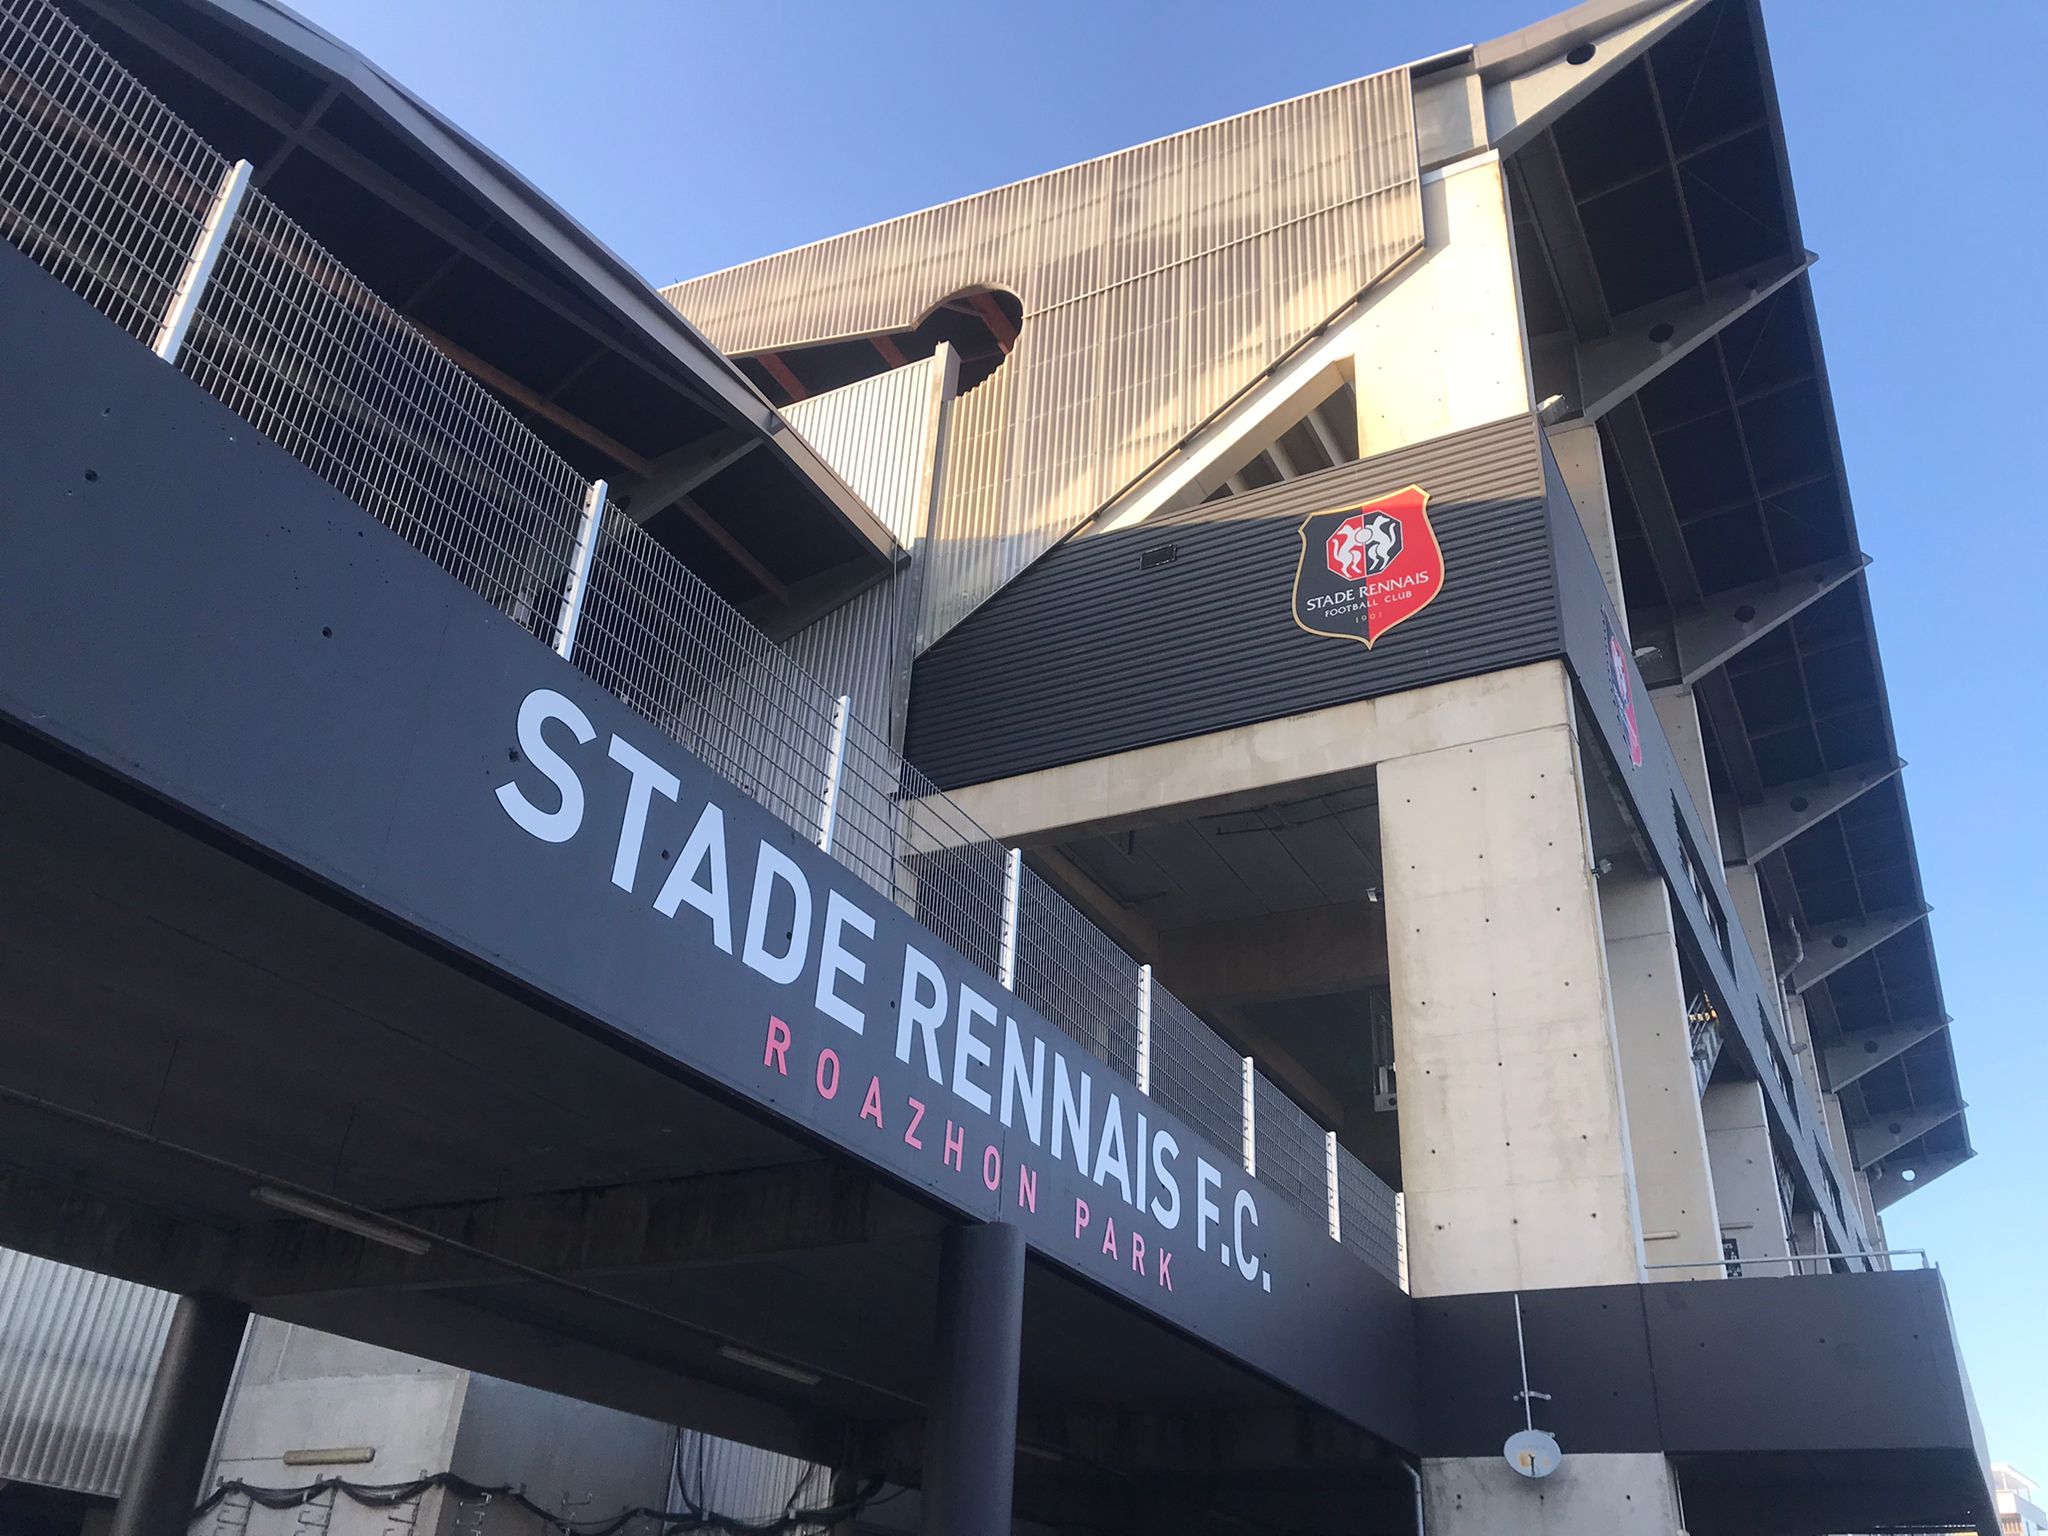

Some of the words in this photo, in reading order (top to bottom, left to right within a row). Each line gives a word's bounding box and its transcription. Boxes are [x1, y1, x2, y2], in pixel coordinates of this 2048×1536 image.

[1306, 589, 1355, 611] STADE
[1359, 571, 1429, 598] RENNAIS
[1325, 599, 1379, 618] FOOTBALL
[1384, 590, 1413, 603] CLUB
[494, 688, 876, 1036] STADE
[895, 942, 1181, 1230] RENNAIS
[1196, 1155, 1272, 1294] F.C.
[763, 1015, 1037, 1214] ROAZHON
[1074, 1197, 1173, 1292] PARK
